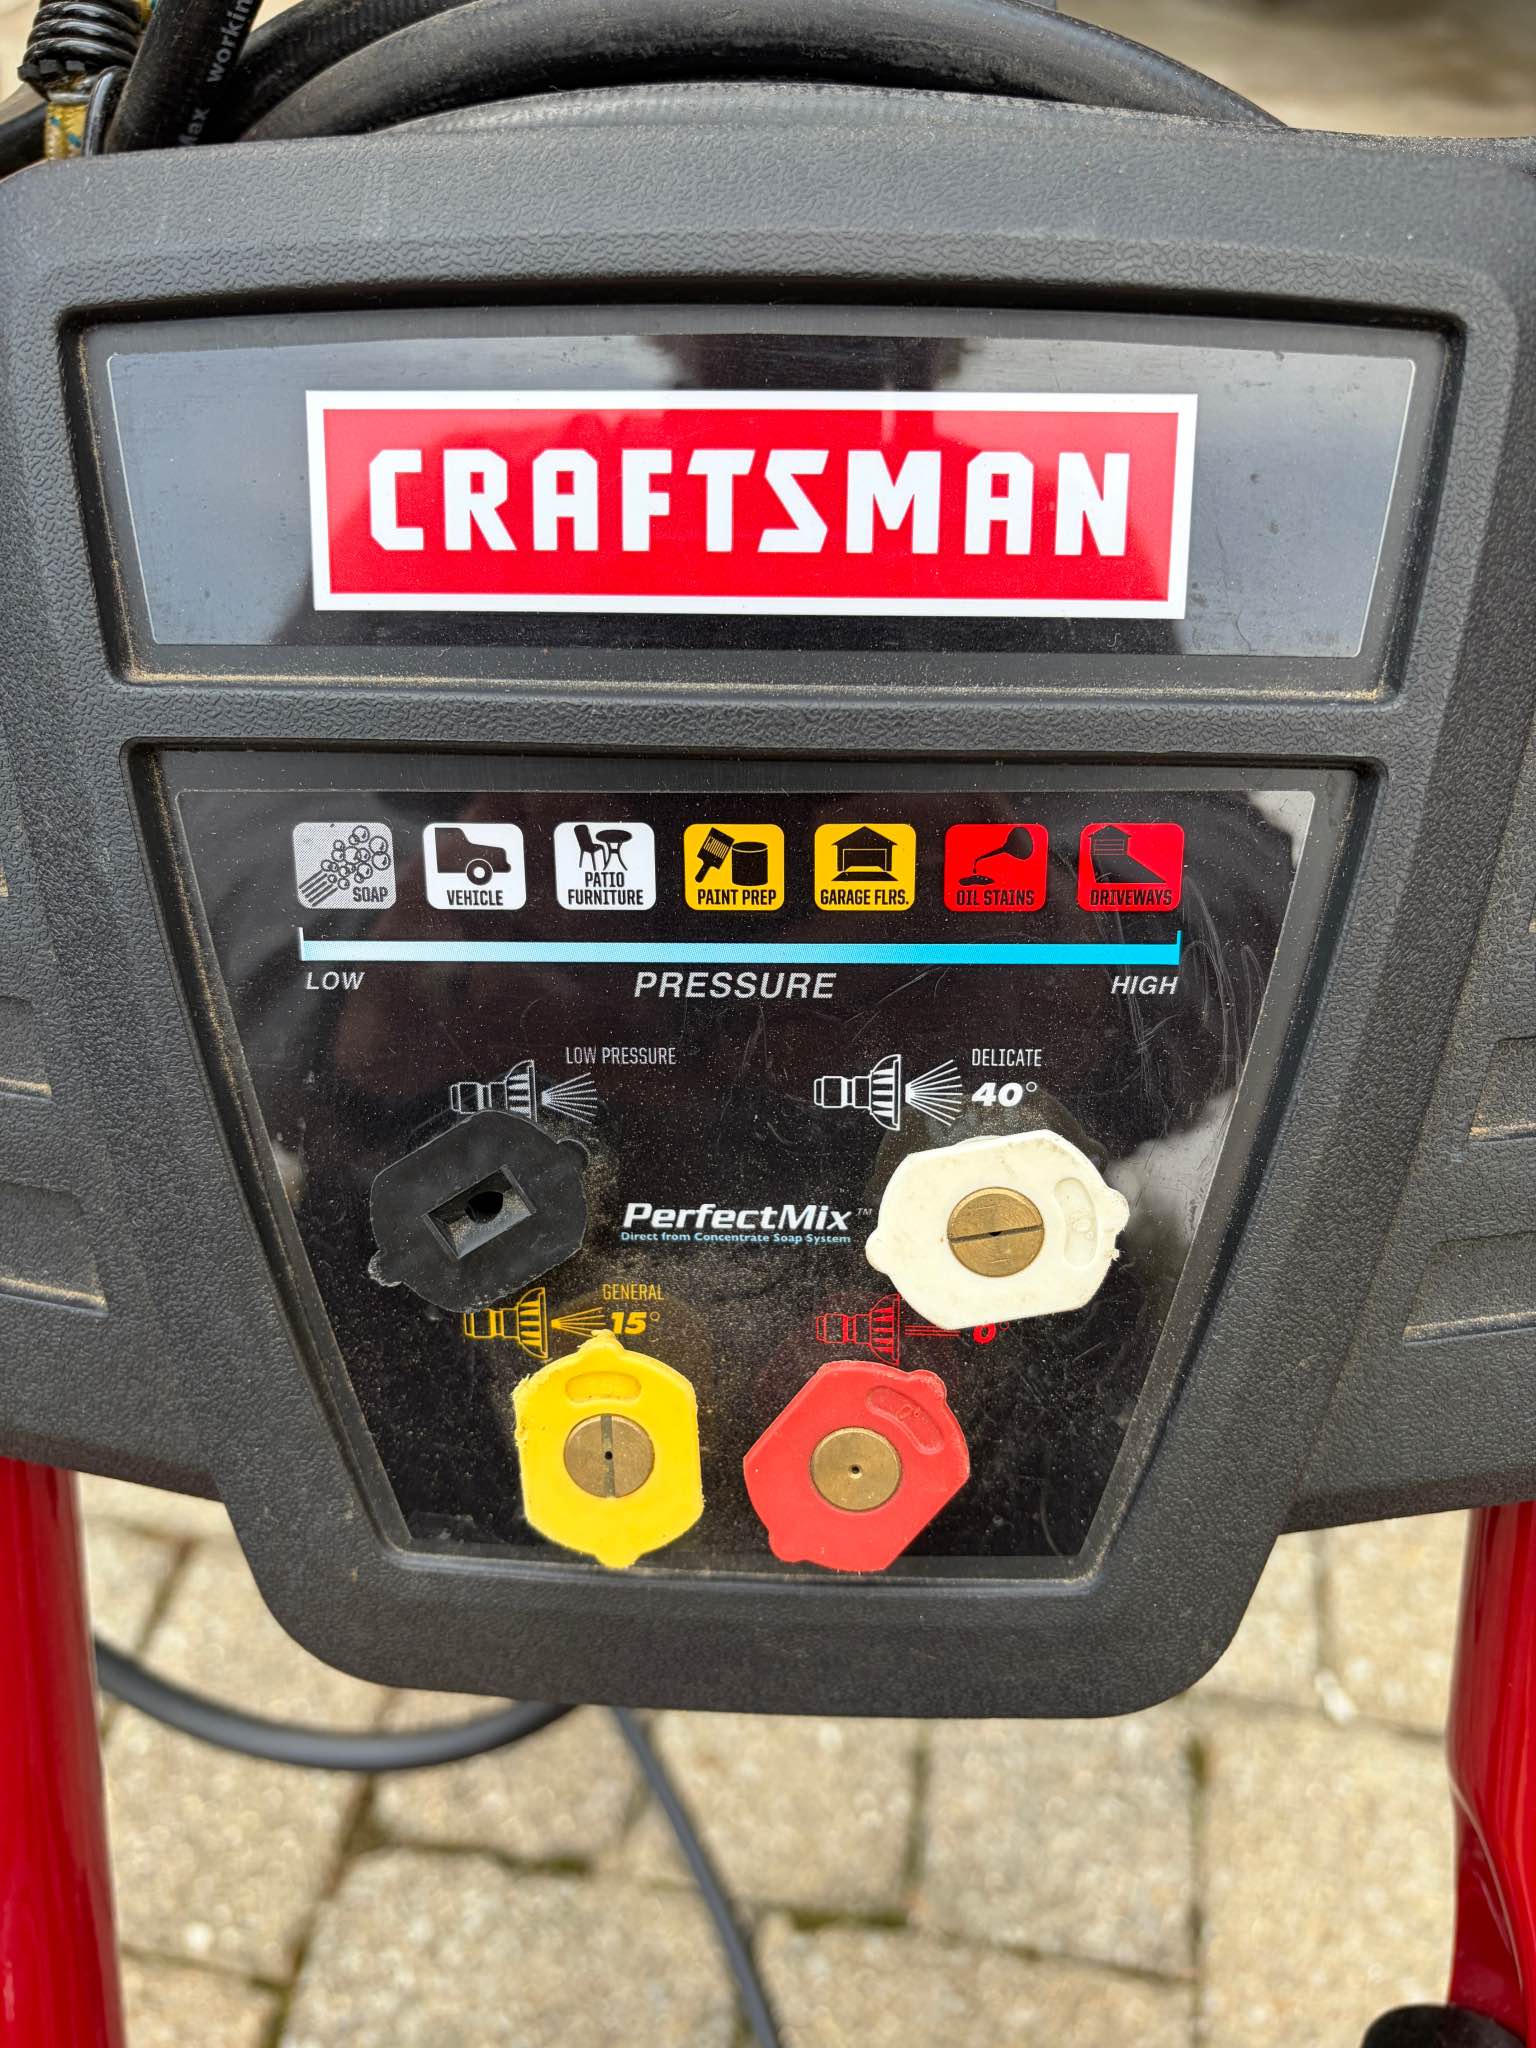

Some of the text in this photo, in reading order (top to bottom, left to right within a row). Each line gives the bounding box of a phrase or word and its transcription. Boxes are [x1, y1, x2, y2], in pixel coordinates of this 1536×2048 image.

[368, 448, 1131, 557] CRAFTSMAN
[584, 871, 625, 888] PATIO
[352, 886, 389, 903] SOAP
[446, 889, 504, 906] VEHICLE
[567, 889, 644, 905] FURNITURE
[697, 889, 777, 906] PAINT PREP
[820, 889, 909, 905] GARAGE FLRS.
[956, 890, 1035, 906] OIL STAINS
[1089, 889, 1172, 906] DRIVEWAYS
[305, 971, 365, 991] LOW
[634, 971, 837, 999] PRESSURE
[1110, 975, 1179, 995] HIGH
[565, 1047, 677, 1065] LOW PRESSURE
[971, 1049, 1042, 1067] DELICATE
[971, 1081, 1038, 1107] 40°
[620, 1232, 852, 1246] Direct from Concentrate Soap System
[602, 1284, 665, 1301] GENERAL
[610, 1310, 661, 1335] 15°
